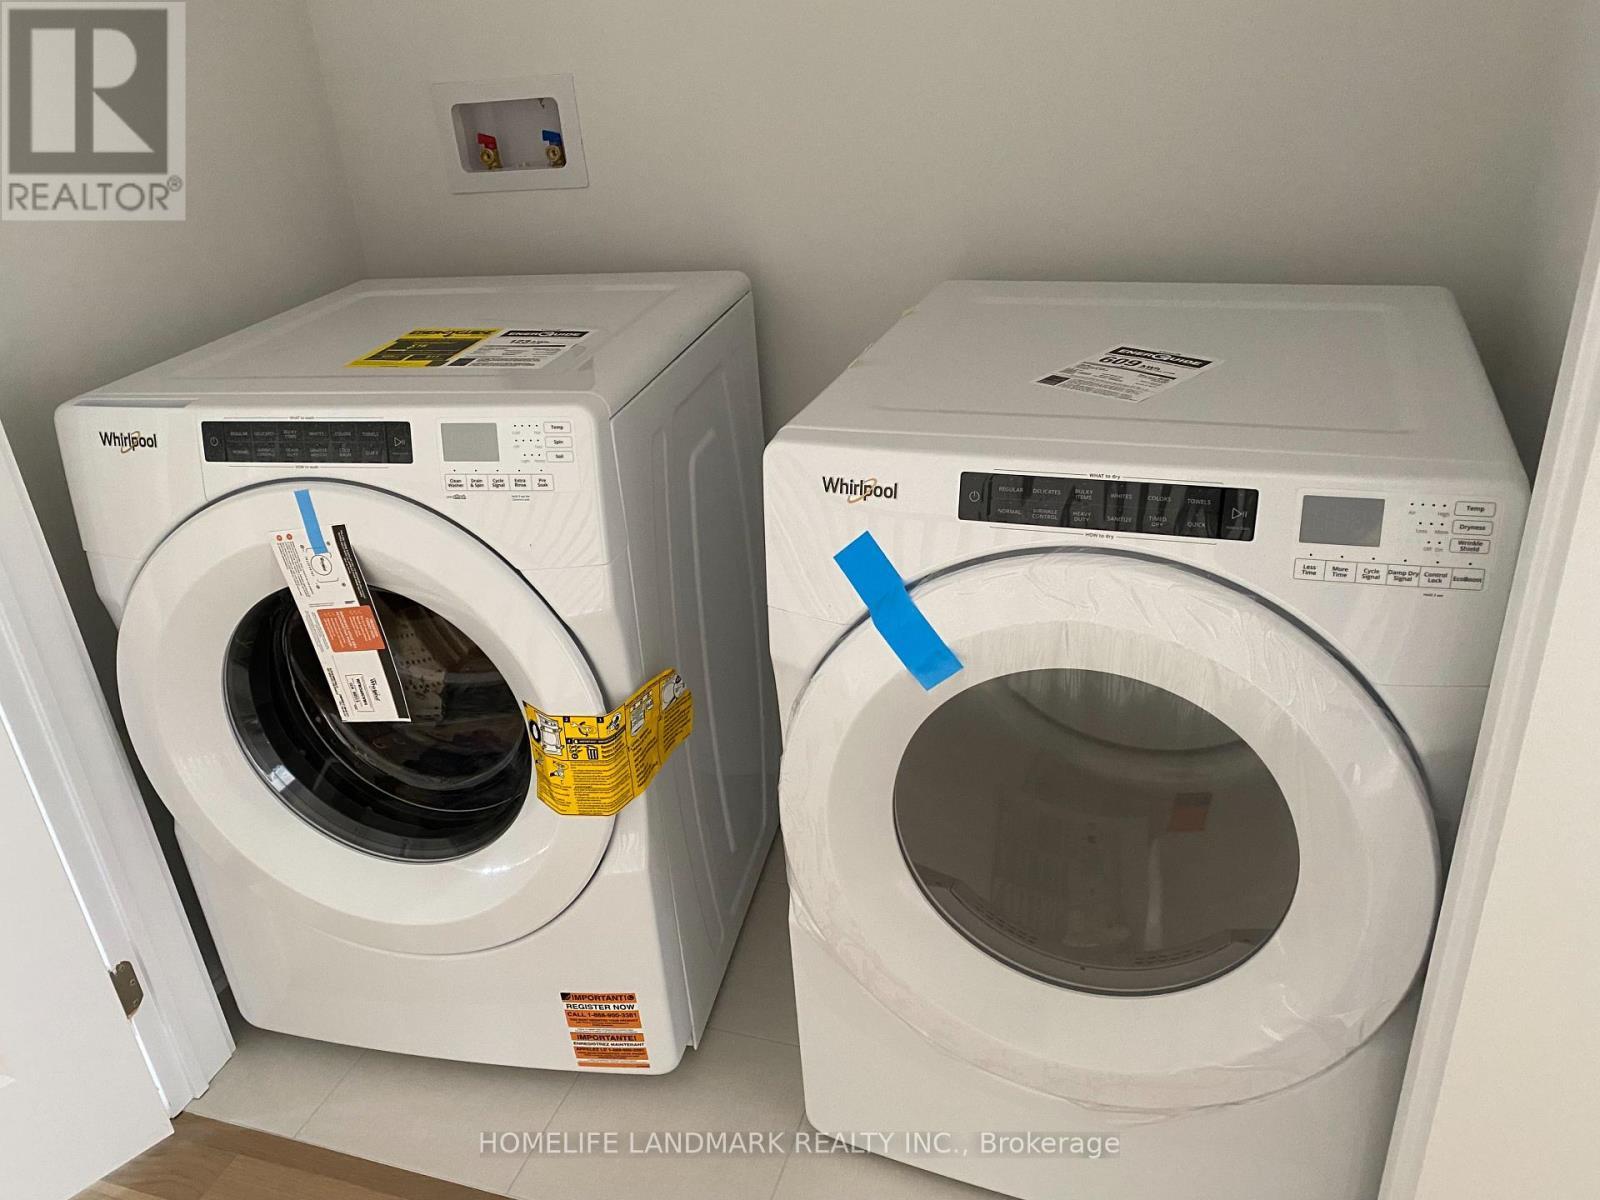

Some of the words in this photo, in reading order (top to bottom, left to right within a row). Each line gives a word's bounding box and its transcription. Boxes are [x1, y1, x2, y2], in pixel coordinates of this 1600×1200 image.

[1099, 356, 1143, 367] 609
[99, 431, 157, 452] Whirlpool
[822, 476, 898, 503] Whirlpool
[1032, 488, 1062, 496] DELICATES
[1146, 495, 1171, 503] COLORS
[998, 507, 1023, 516] NORMAL
[1466, 505, 1485, 513] Temp
[1032, 513, 1058, 521] CONTROL
[1072, 510, 1092, 518] HEAVY
[1148, 514, 1168, 522] TIMED
[1073, 515, 1091, 523] DUTY
[1106, 515, 1132, 523] SANITIZE
[1187, 521, 1206, 529] QUICK
[1302, 563, 1317, 571] Less
[1361, 573, 1381, 581] Signal
[1387, 569, 1407, 577] Damp
